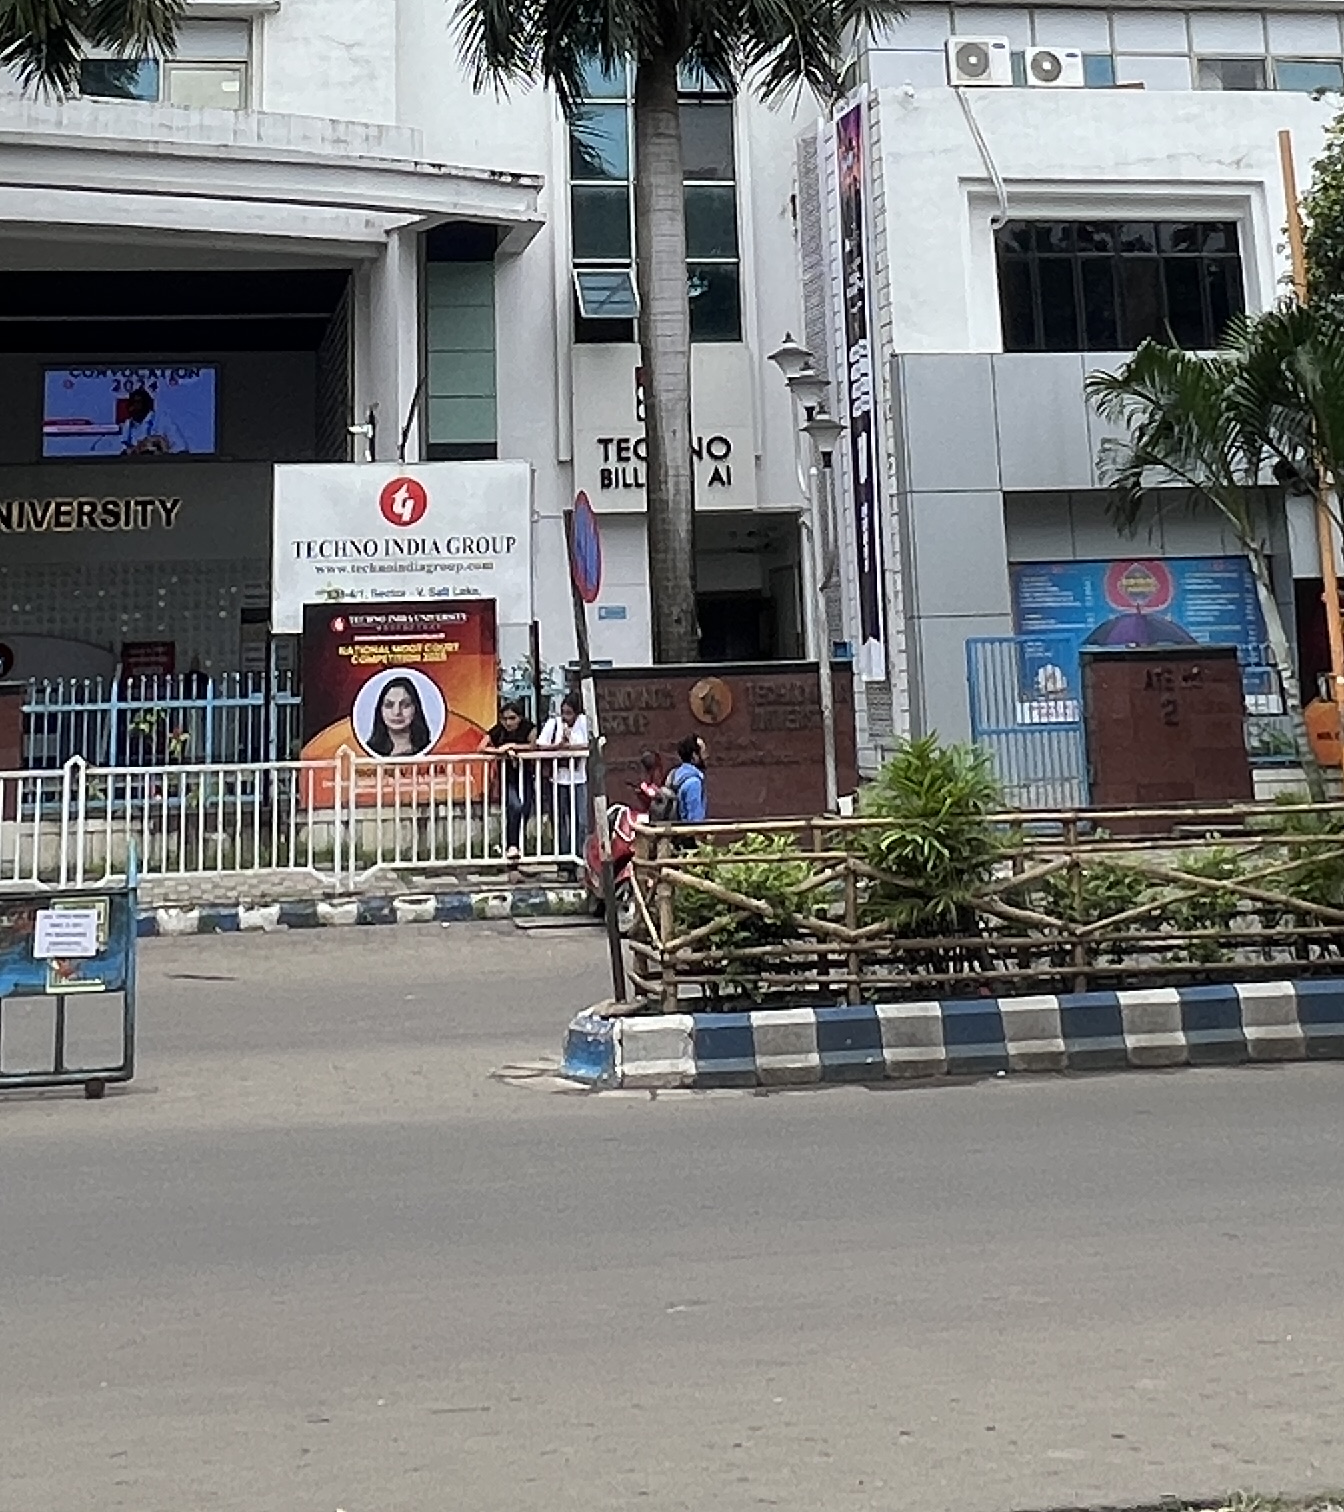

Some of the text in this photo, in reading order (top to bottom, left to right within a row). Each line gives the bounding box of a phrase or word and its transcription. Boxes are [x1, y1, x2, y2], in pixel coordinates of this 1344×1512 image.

[708, 465, 732, 487] AI
[291, 535, 517, 559] TECHNO INDIA GROUP
